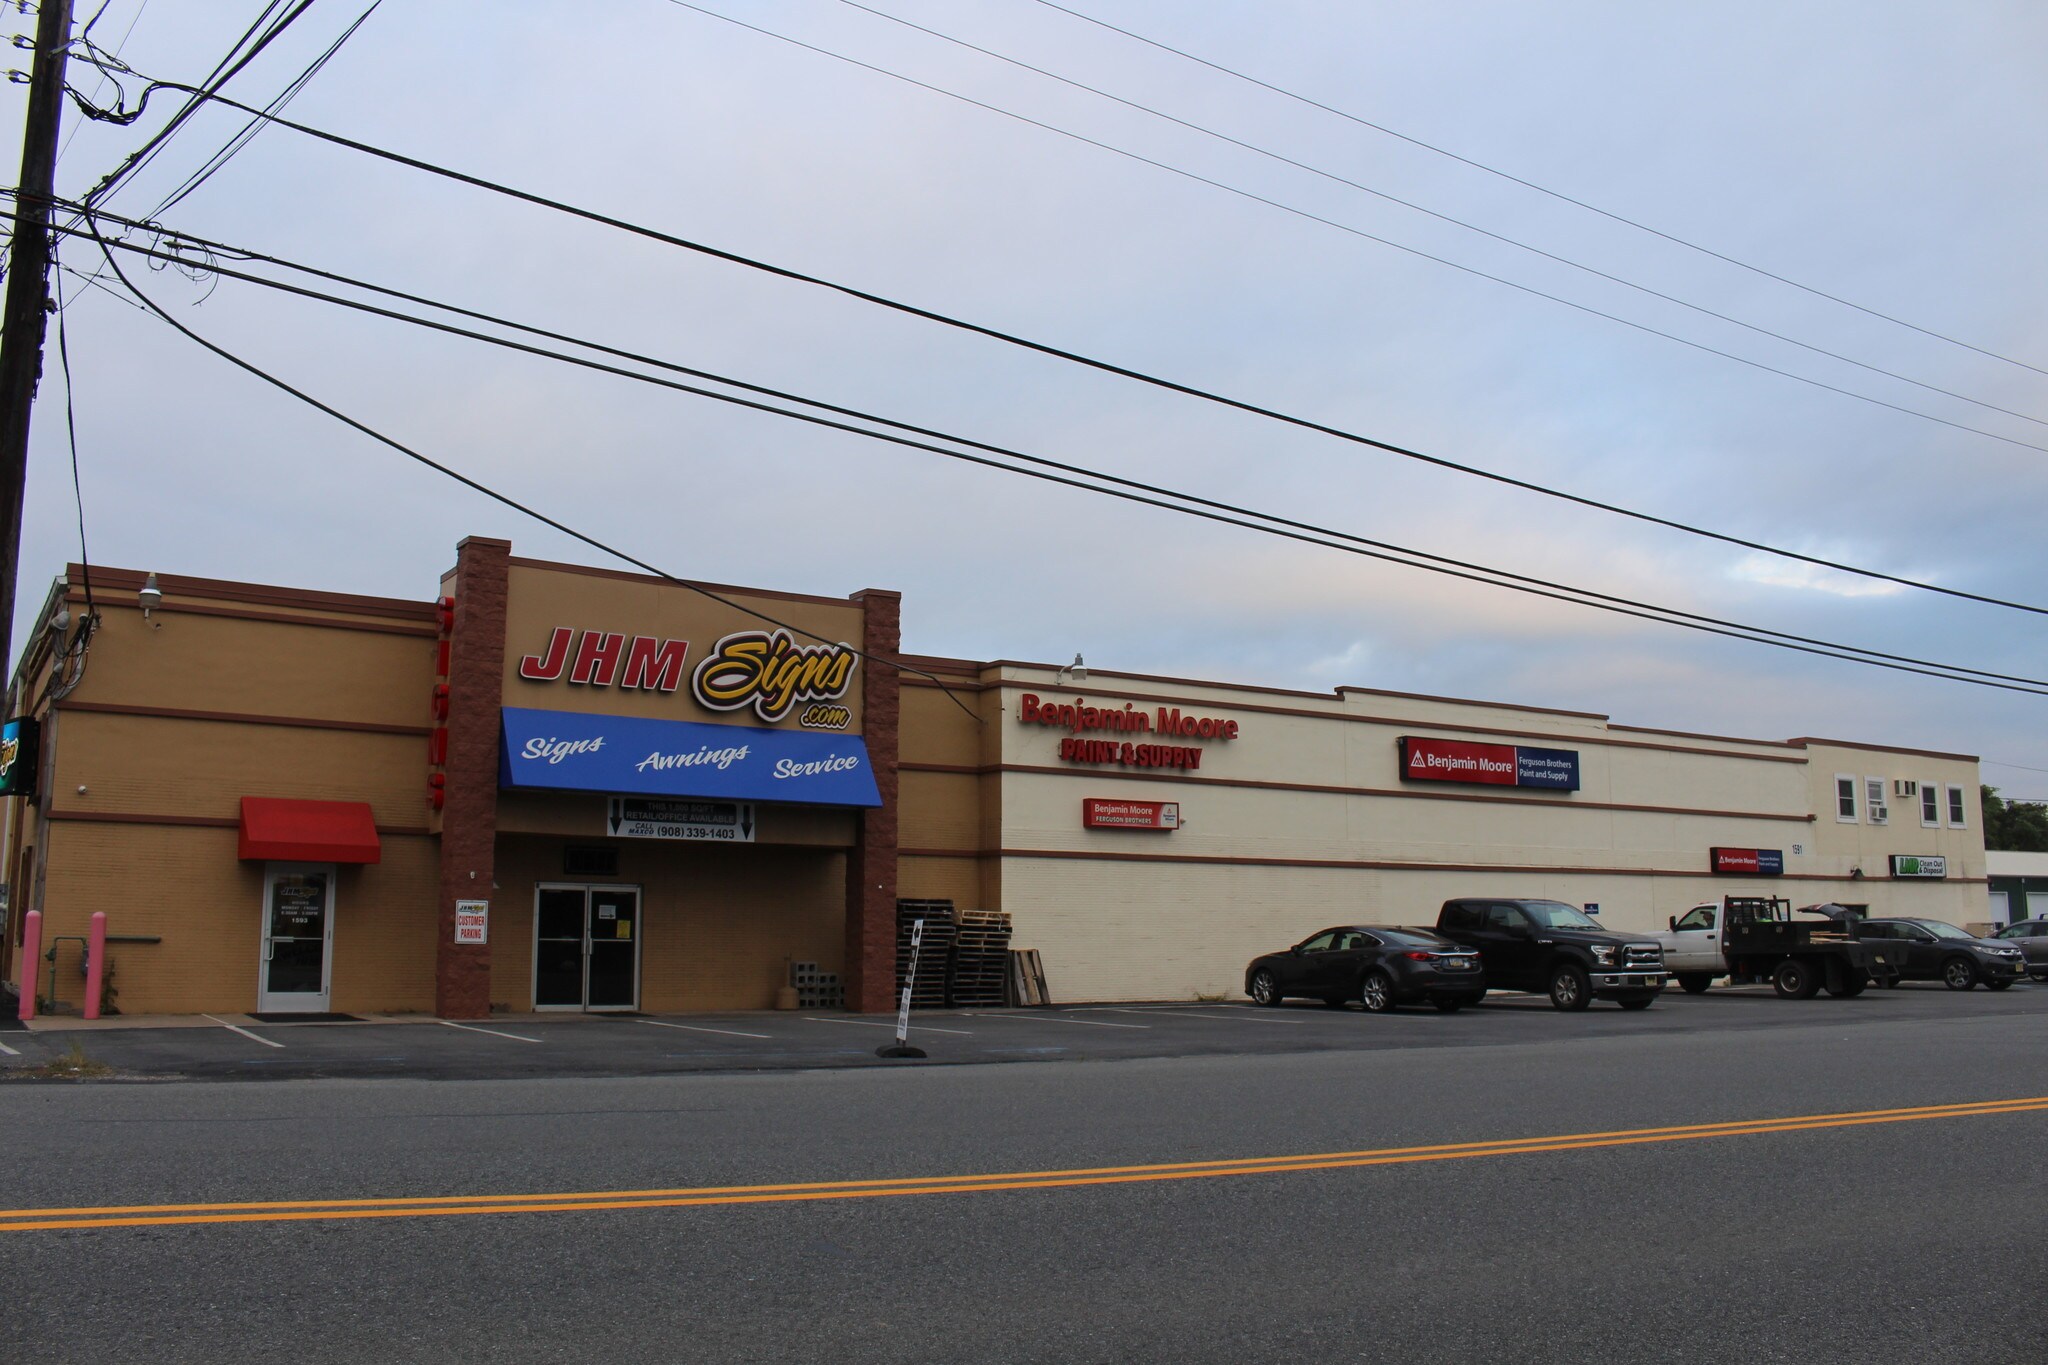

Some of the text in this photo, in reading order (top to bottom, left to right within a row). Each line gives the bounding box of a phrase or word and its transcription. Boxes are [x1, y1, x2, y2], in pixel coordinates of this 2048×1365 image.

[519, 626, 858, 723] JHM Signs
[801, 704, 852, 729] .com
[1020, 693, 1239, 739] Benjamin Moore
[521, 736, 606, 764] Signs
[1060, 738, 1203, 770] PAINT & SUPPLY
[635, 745, 752, 772] Awnings
[1427, 753, 1513, 773] Benjamin Moore
[1518, 756, 1572, 769] Ferguson Brothers
[773, 754, 860, 779] Service
[1519, 768, 1568, 782] Paint and Supply
[1095, 803, 1153, 815] Benjamin Moore
[626, 811, 735, 824] RETAIL/OFFICE AVAILABLE
[1096, 815, 1152, 825] FERGUSON BROTHERS
[628, 828, 655, 836] MAXCO
[635, 822, 653, 830] CALL
[657, 825, 735, 840] (908) 339-1403
[1933, 860, 1943, 868] Out
[1923, 867, 1943, 875] Disposal
[459, 915, 485, 926] CUSTOMER
[460, 928, 481, 939] PARKING
